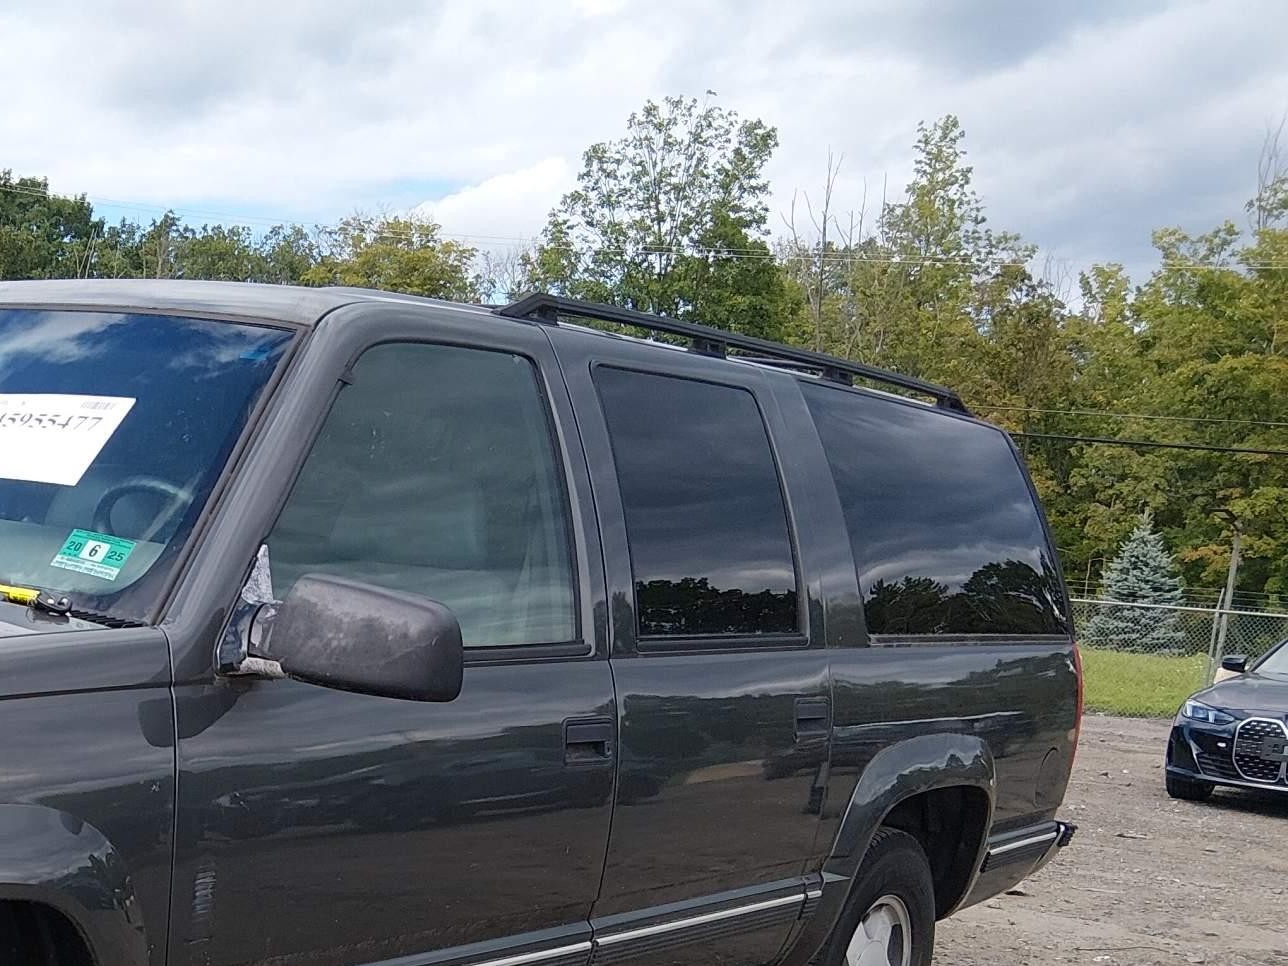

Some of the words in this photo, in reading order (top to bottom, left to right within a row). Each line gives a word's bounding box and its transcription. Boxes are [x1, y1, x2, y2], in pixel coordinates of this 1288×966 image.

[66, 540, 83, 552] 20
[88, 544, 102, 558] 6
[108, 550, 125, 562] 25
